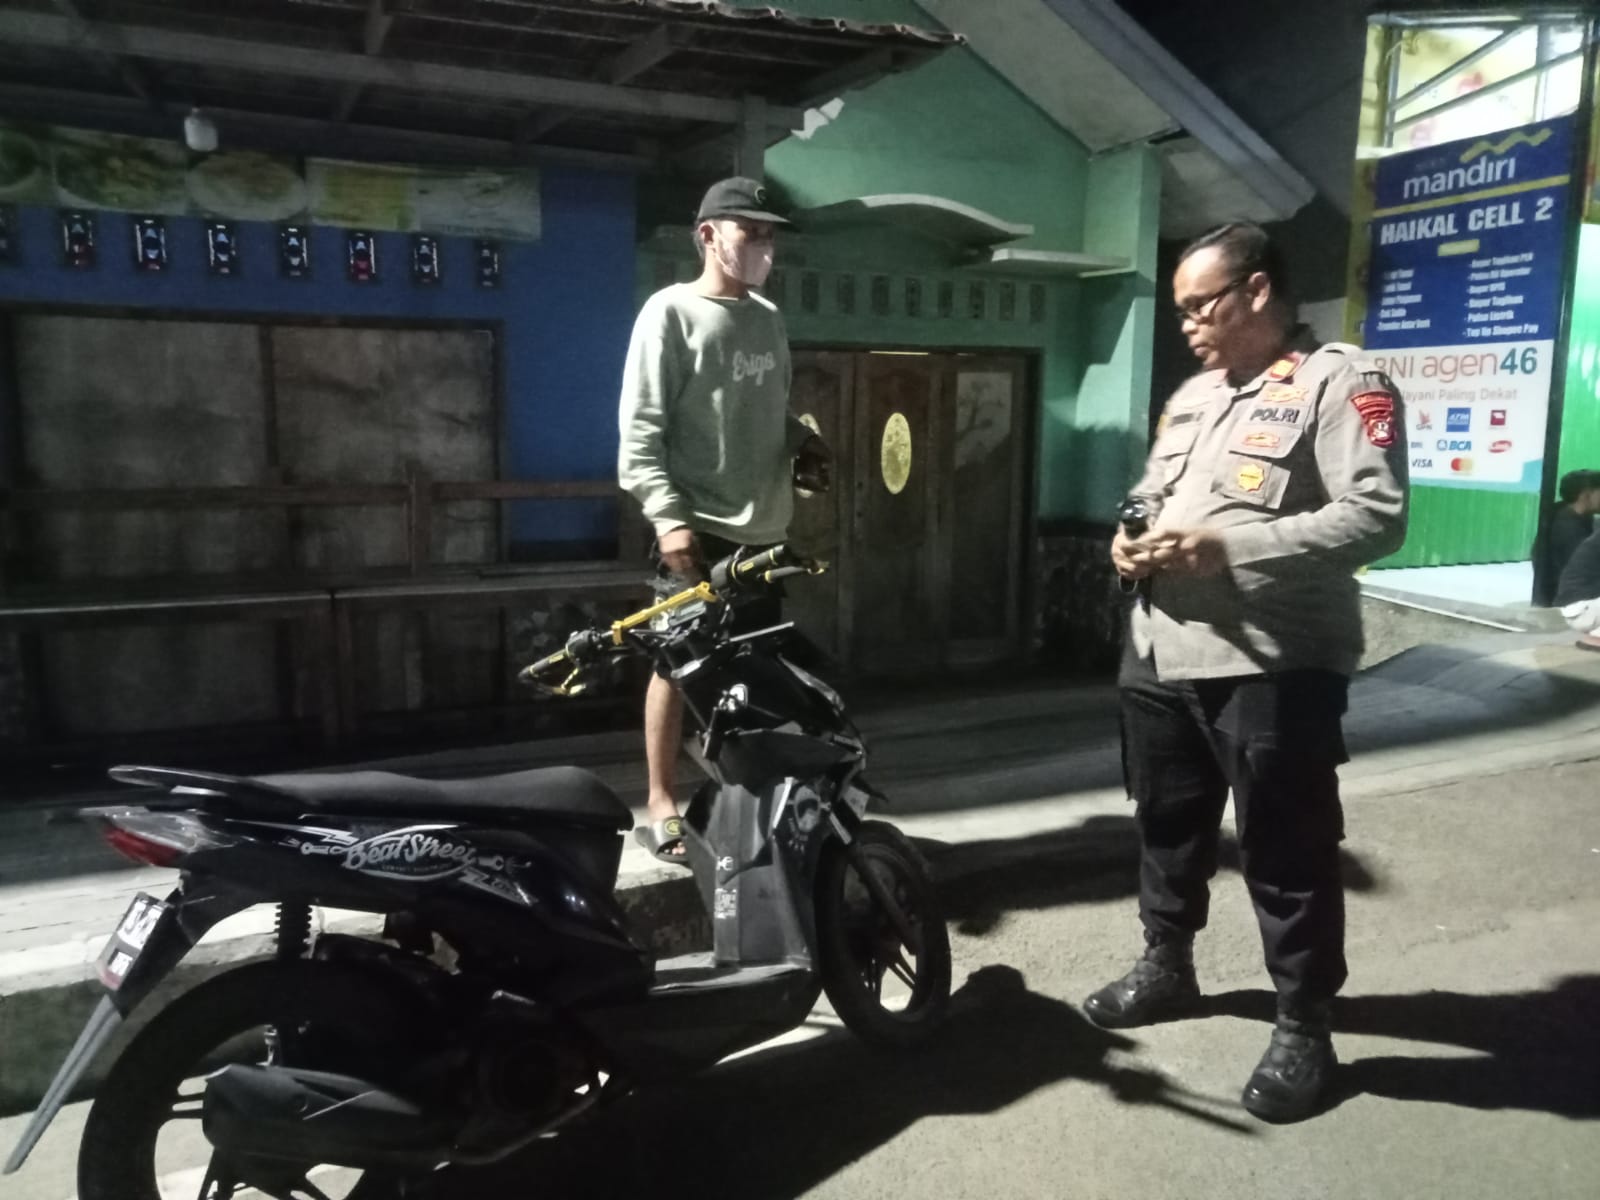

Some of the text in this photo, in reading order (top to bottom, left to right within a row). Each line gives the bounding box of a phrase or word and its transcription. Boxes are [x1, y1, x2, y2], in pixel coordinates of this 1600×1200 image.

[1403, 156, 1516, 199] mandiri
[1380, 197, 1555, 245] HAIKAL CELL 2
[1374, 356, 1415, 379] BNI
[1438, 388, 1476, 403] Paling
[1480, 387, 1517, 401] Dekat
[1250, 407, 1300, 423] POLRI
[1448, 440, 1472, 451] BCA
[1411, 458, 1433, 468] VISA
